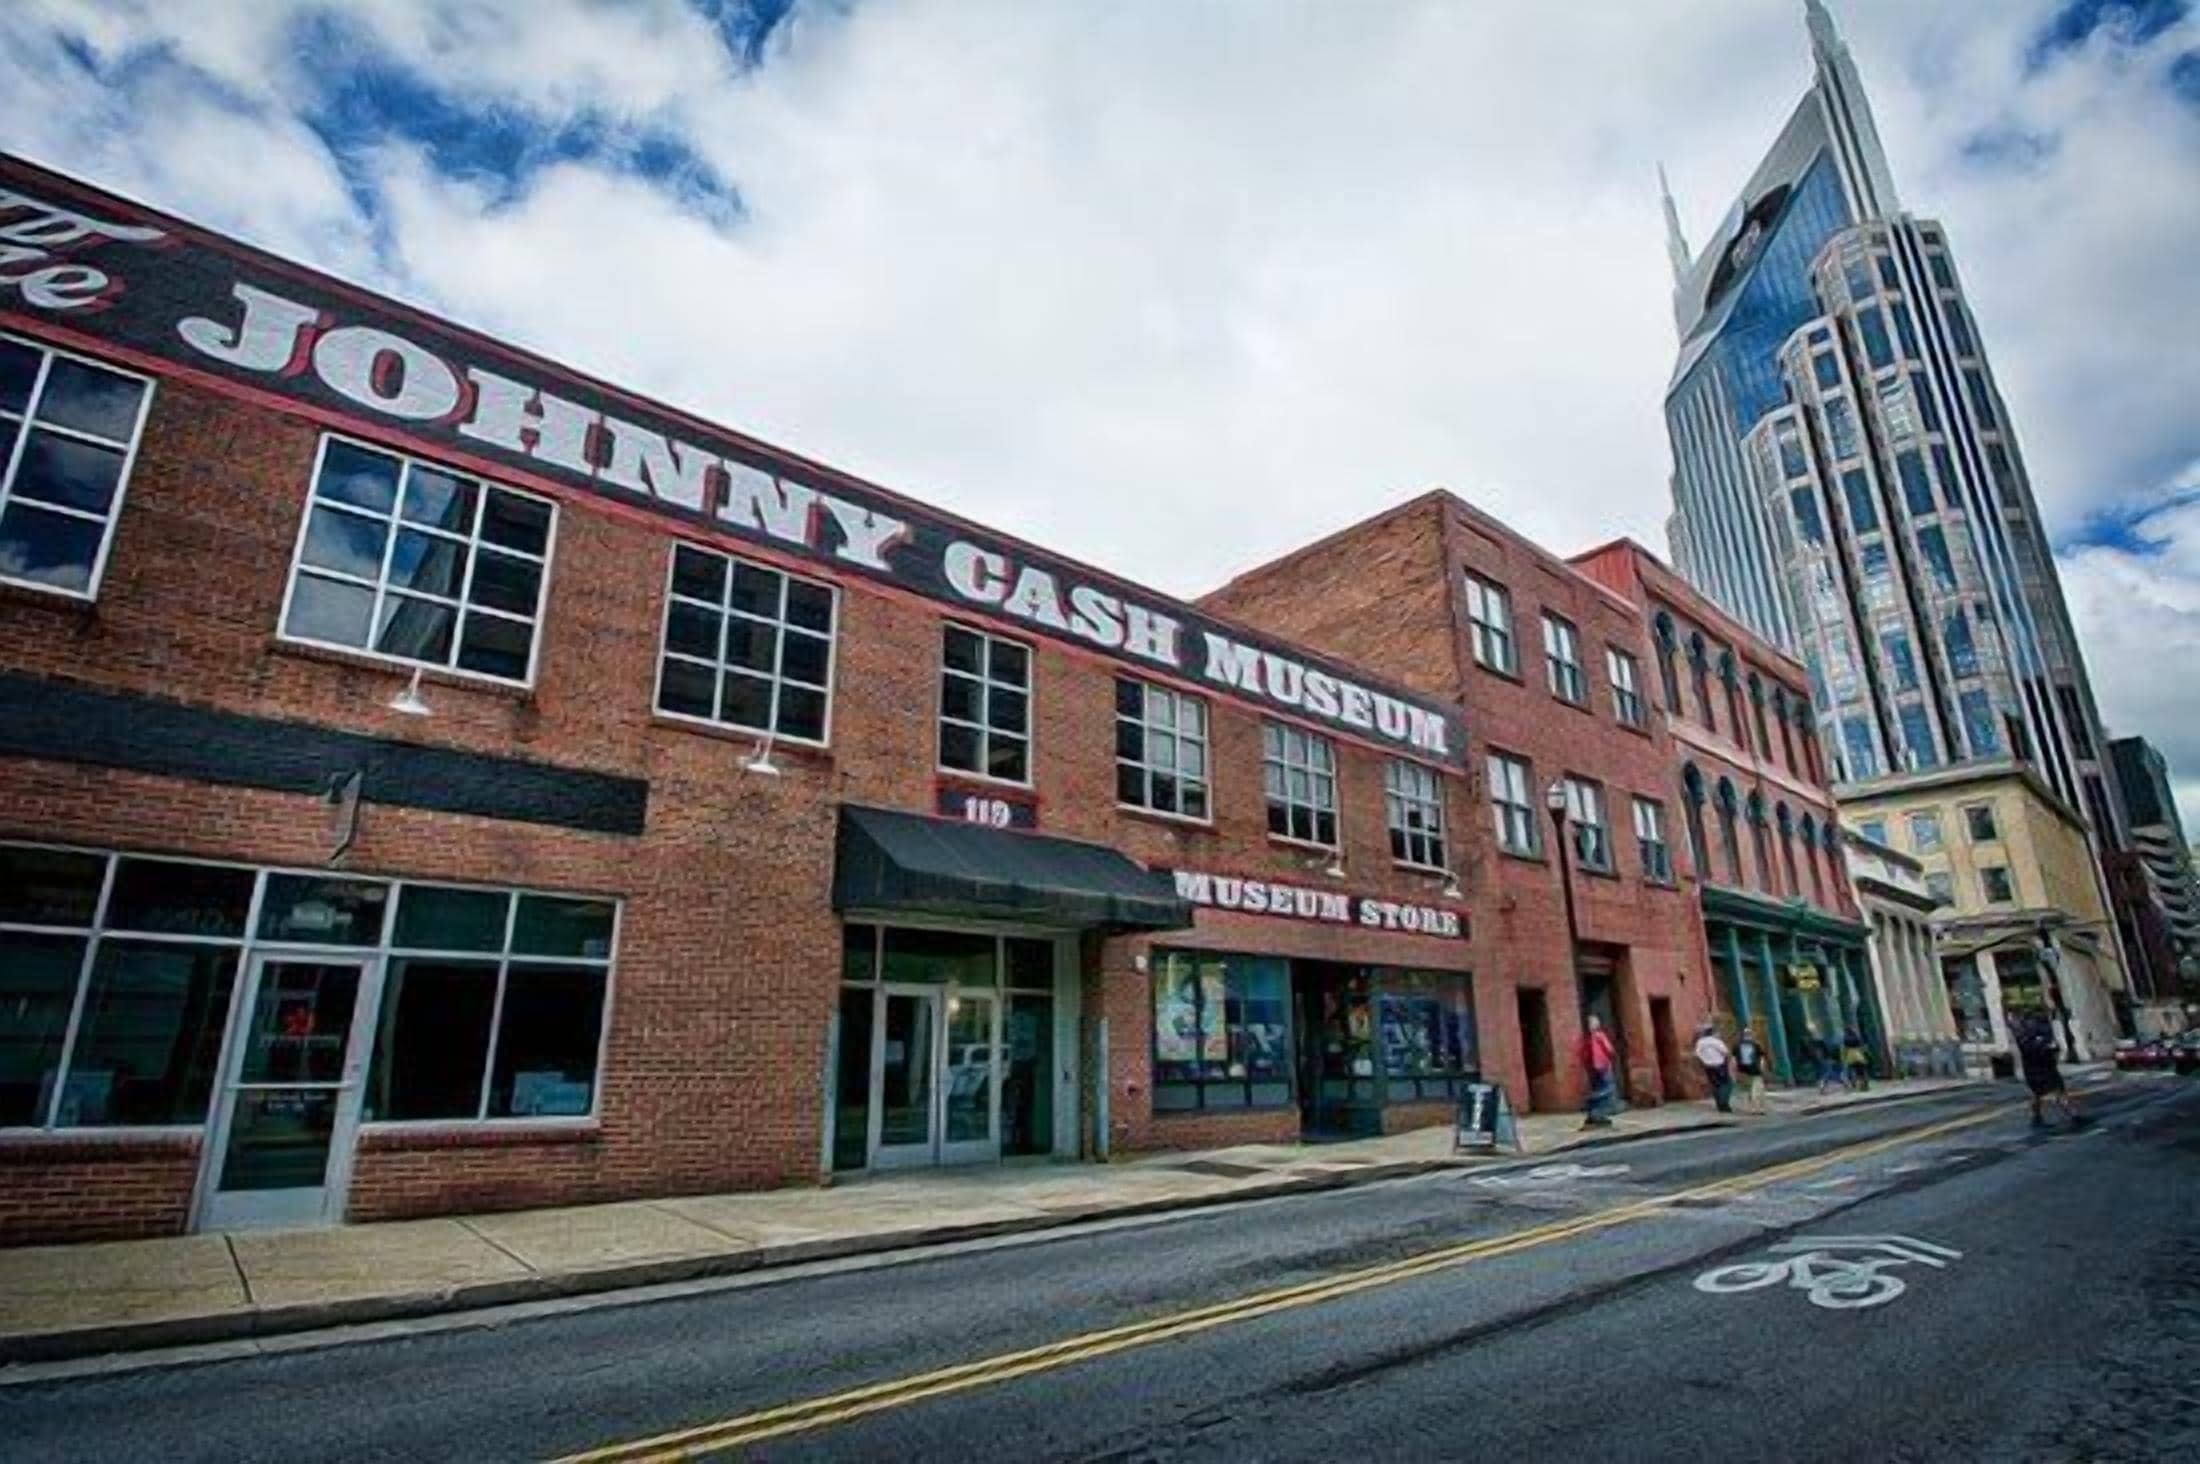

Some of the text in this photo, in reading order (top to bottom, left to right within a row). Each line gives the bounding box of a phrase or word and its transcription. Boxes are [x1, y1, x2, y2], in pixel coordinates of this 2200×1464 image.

[177, 282, 1448, 755] JOHNNY CASH MUSEUM
[965, 796, 1010, 829] 119
[1173, 870, 1460, 937] MUSEUM STORE
